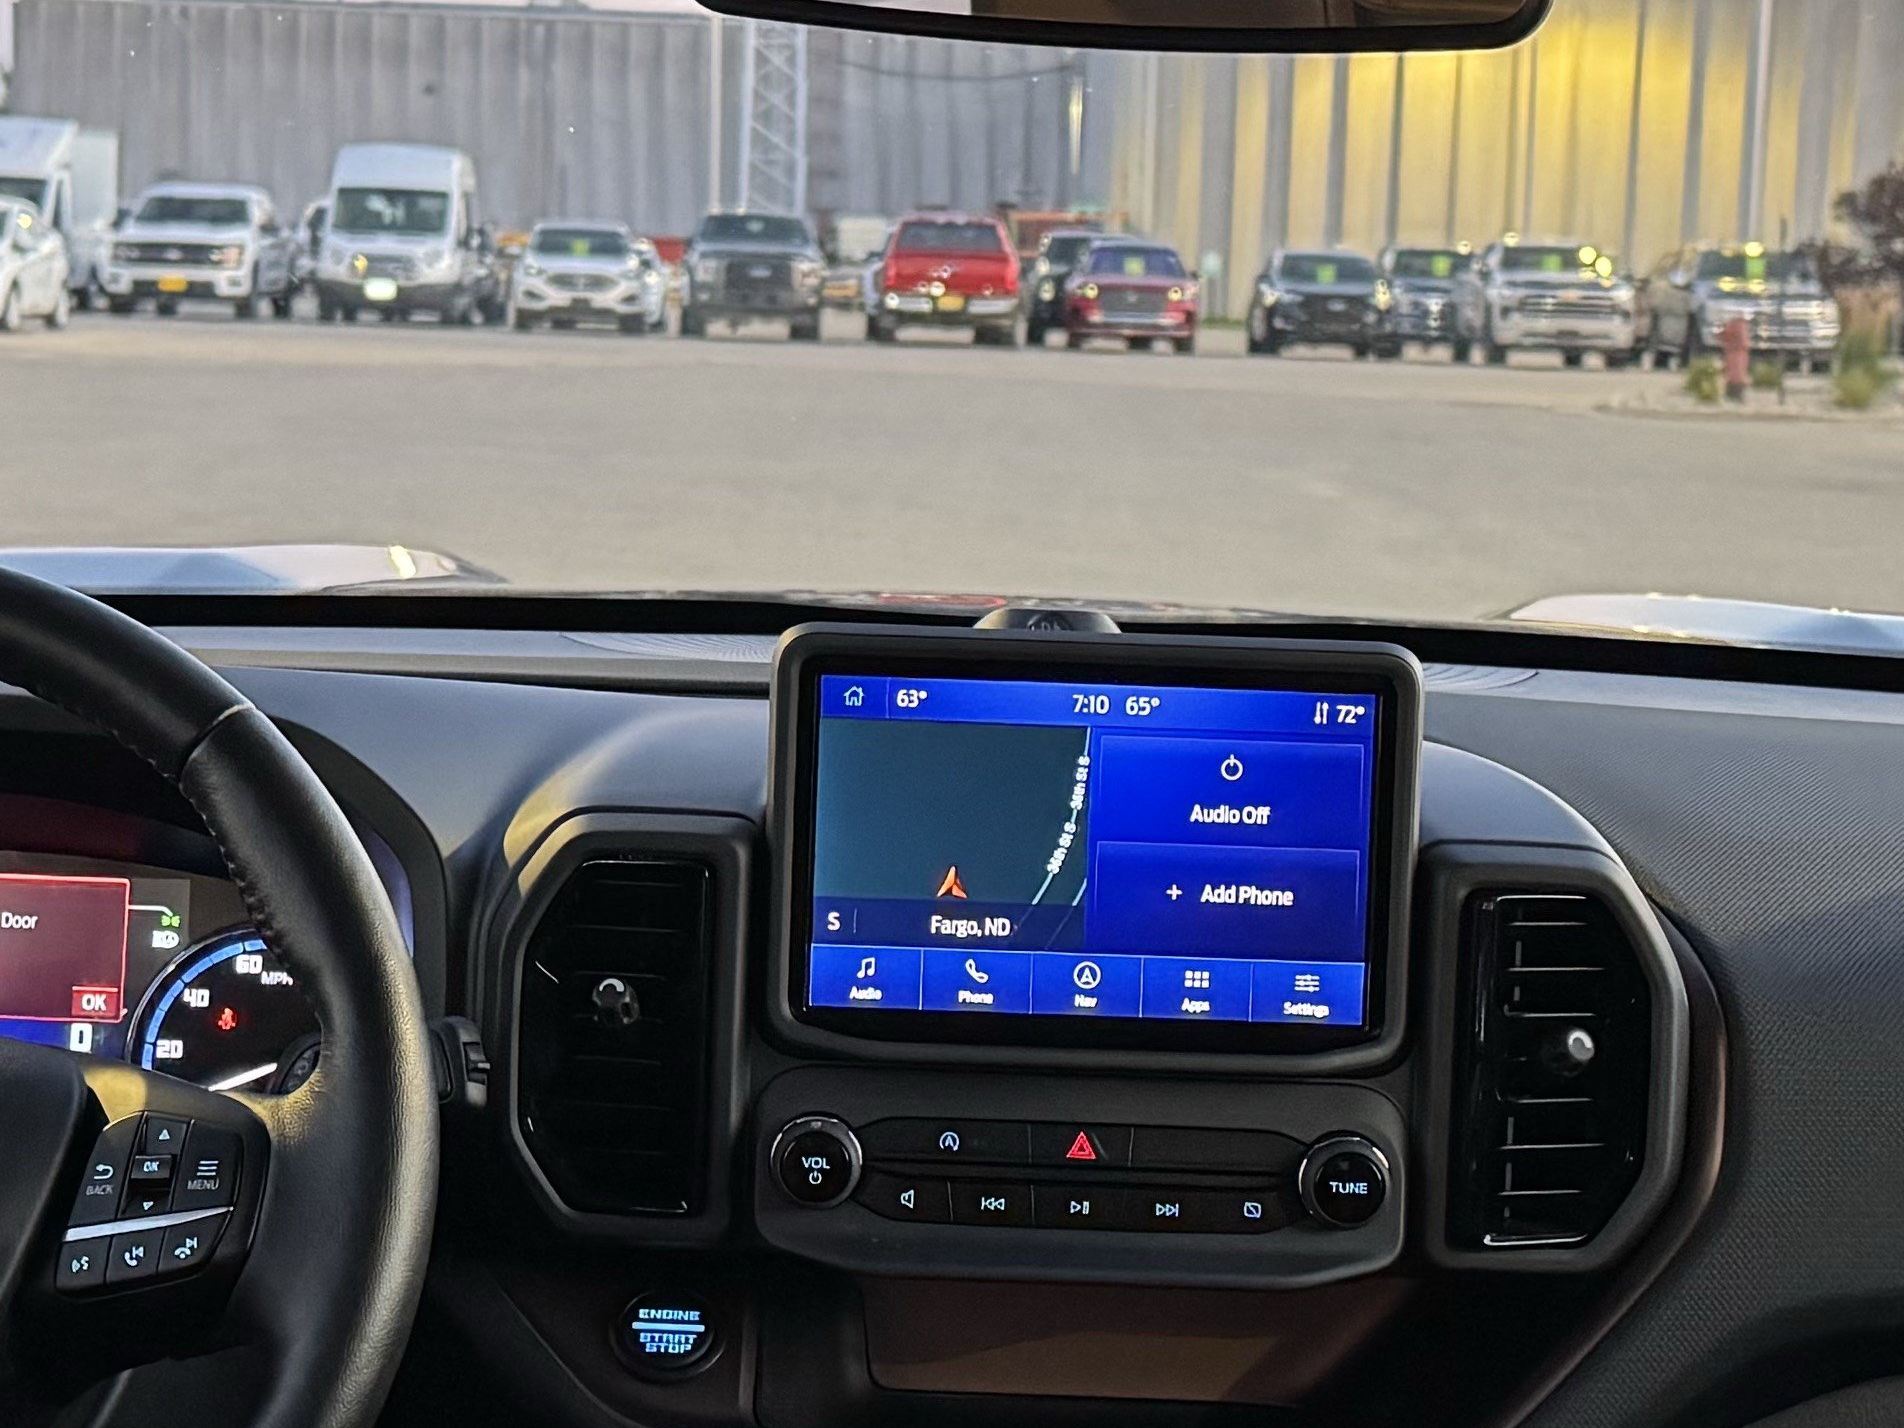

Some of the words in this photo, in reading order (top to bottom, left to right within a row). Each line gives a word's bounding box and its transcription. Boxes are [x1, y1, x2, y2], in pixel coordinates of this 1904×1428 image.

[896, 690, 928, 709] 63°
[1072, 694, 1110, 714] 7:10
[1125, 696, 1161, 715] 65°
[1335, 704, 1366, 725] 72°
[1190, 803, 1240, 825] Audio
[1241, 805, 1271, 826] Off
[1200, 885, 1237, 905] Add
[1238, 886, 1294, 907] Phone
[0, 911, 38, 930] Door
[827, 912, 842, 931] S
[930, 916, 982, 938] Fargo,
[983, 918, 1011, 936] ND
[236, 954, 264, 974] 60
[183, 988, 210, 1007] 40
[849, 986, 883, 1001] Audio
[958, 989, 993, 1006] Phone
[1075, 994, 1097, 1009] Nav
[81, 994, 107, 1012] OK
[1181, 998, 1211, 1014] Apps
[1283, 1001, 1330, 1019] Settings
[70, 1023, 94, 1053] 0
[156, 1040, 184, 1059] 20
[143, 1161, 160, 1172] OK
[801, 1156, 831, 1170] VOL
[86, 1185, 113, 1196] BACK
[187, 1179, 219, 1190] MENU
[1329, 1181, 1368, 1195] TUNE
[639, 1309, 701, 1322] ENGINE
[639, 1333, 698, 1345] START
[646, 1343, 692, 1354] STOP
